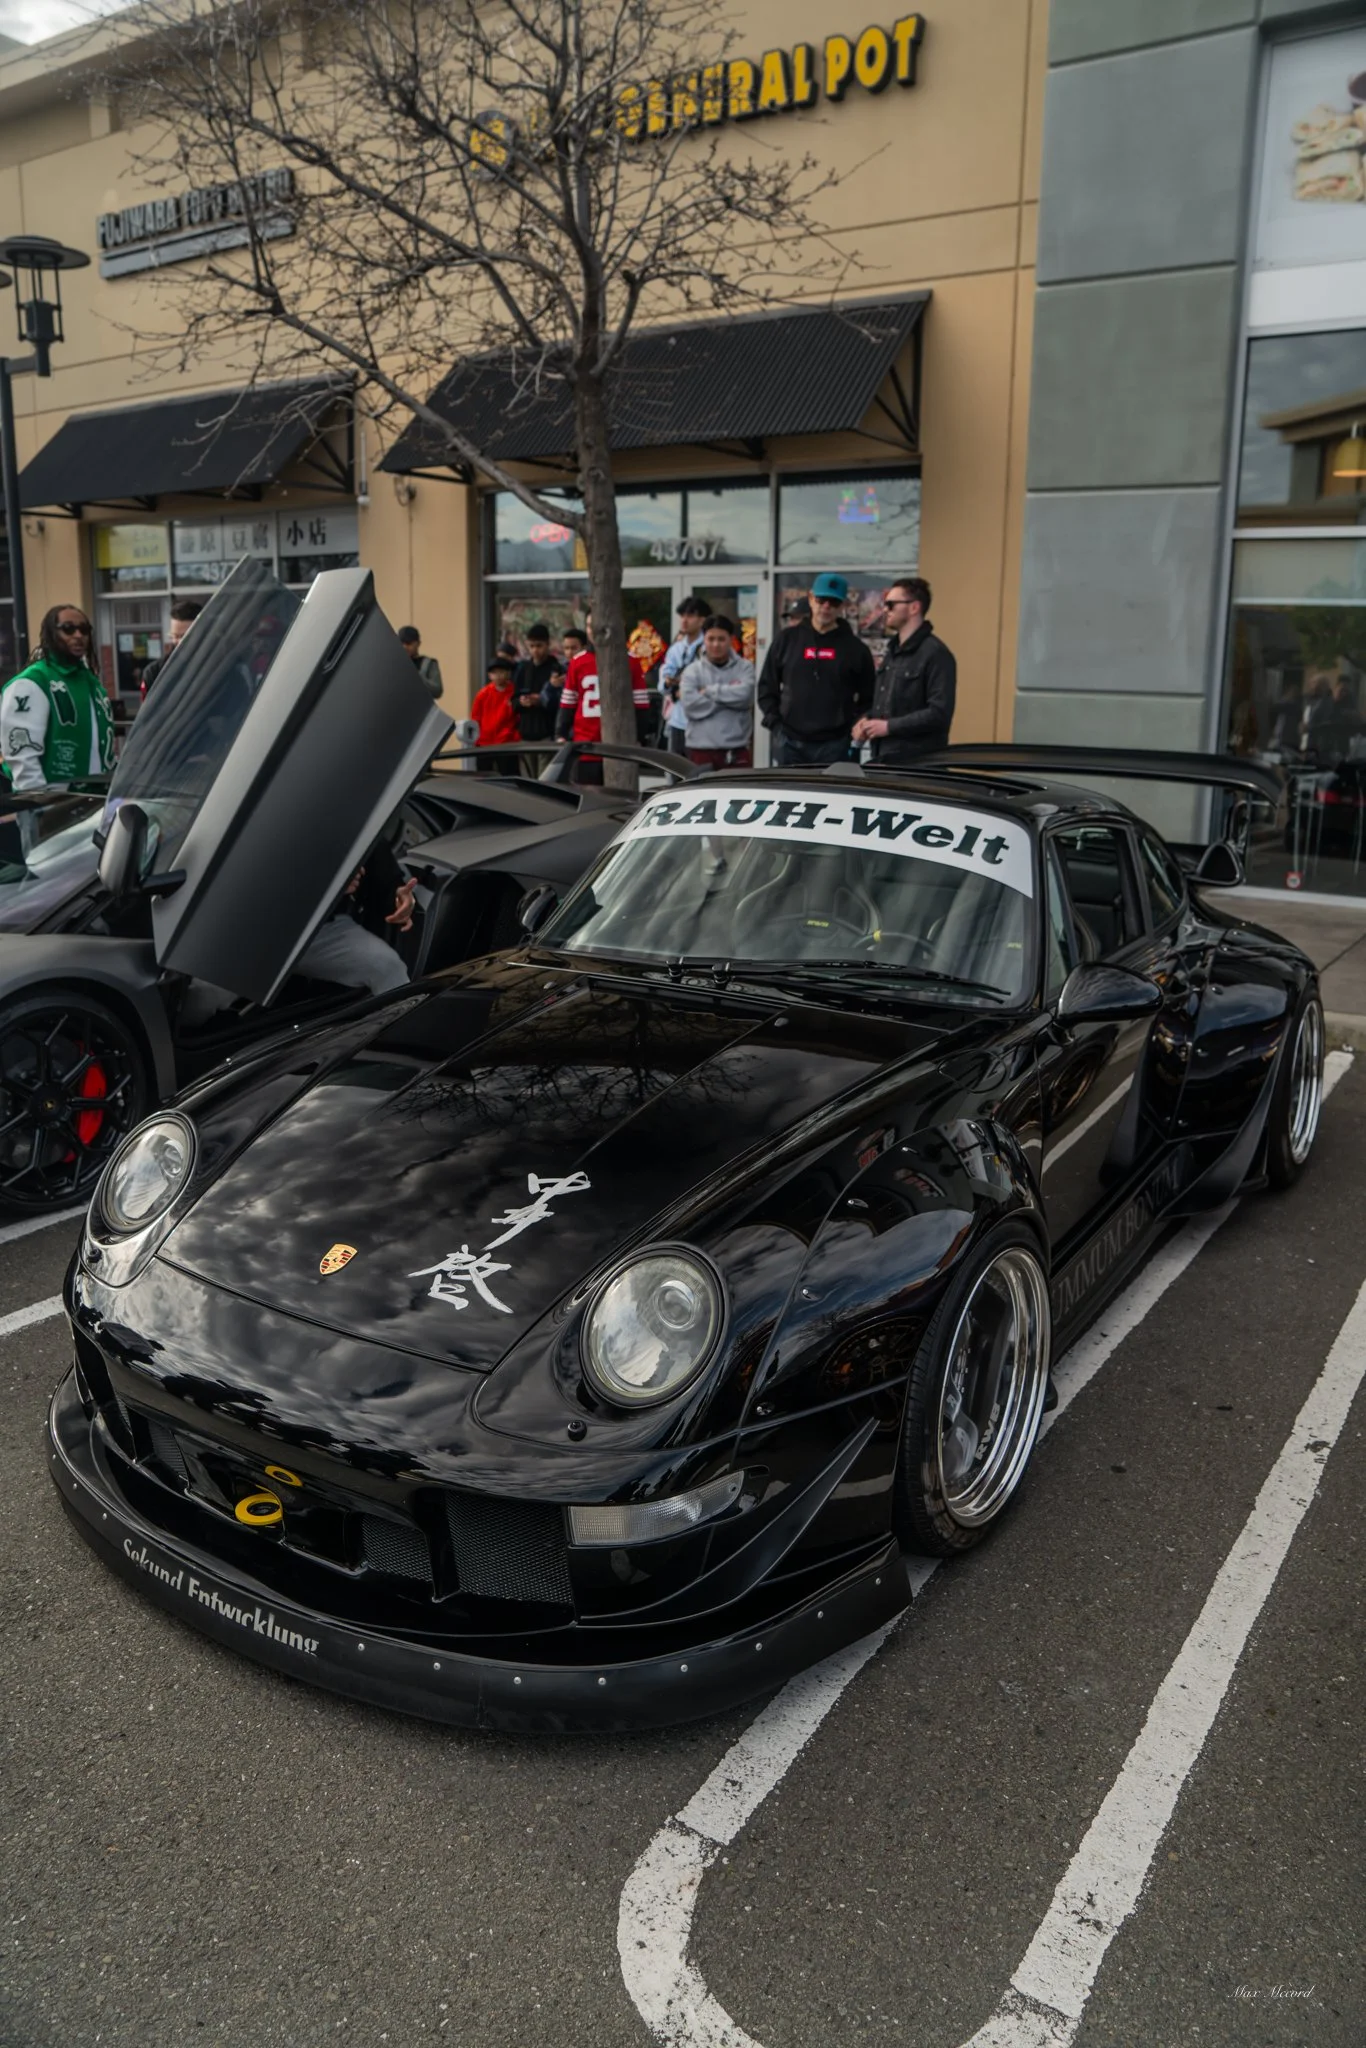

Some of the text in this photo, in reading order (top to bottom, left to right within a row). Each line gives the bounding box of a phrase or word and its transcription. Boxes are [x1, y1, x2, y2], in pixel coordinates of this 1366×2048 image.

[615, 44, 816, 138] GENERAL
[825, 14, 921, 97] POT
[98, 198, 181, 248] FUJIWARA
[633, 798, 1010, 866] RAUH-Welt
[1051, 1216, 1123, 1326] UMMUM
[974, 1402, 1001, 1461] RWB
[123, 1538, 320, 1656] Sekund Entwicklung
